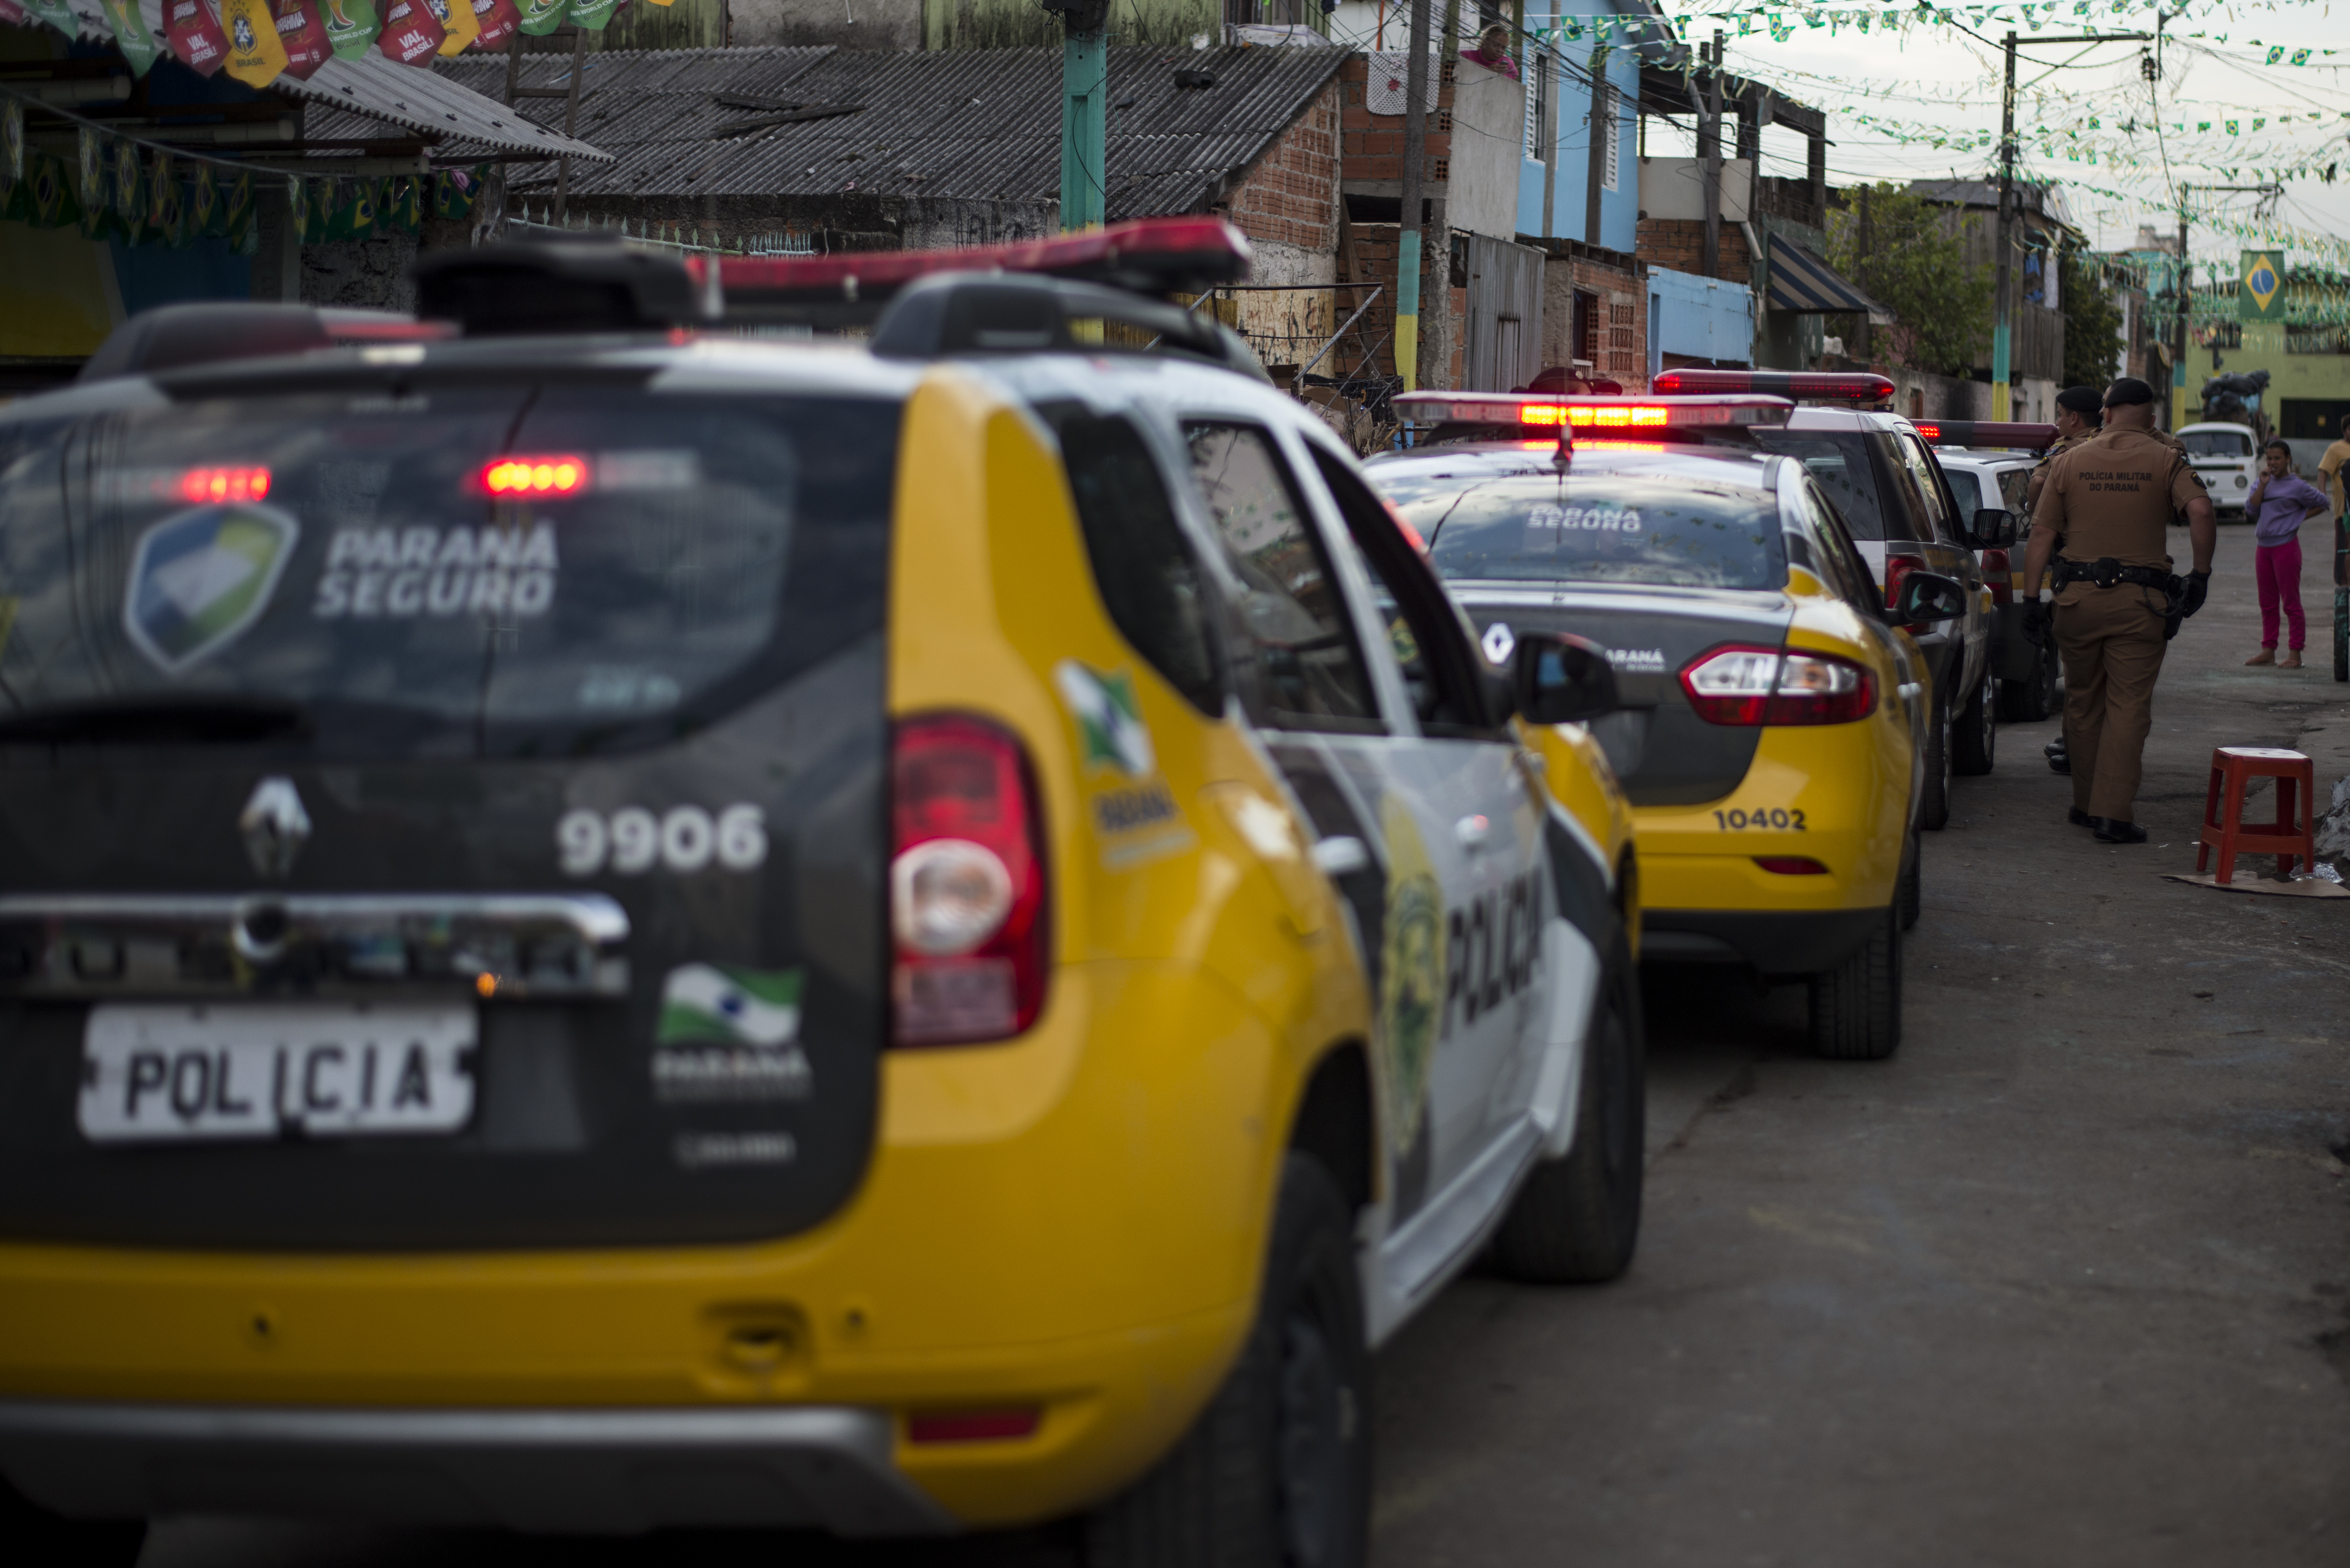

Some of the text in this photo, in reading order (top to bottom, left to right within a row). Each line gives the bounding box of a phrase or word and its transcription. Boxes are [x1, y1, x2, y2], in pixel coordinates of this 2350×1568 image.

[174, 0, 196, 19] BRAHMA
[388, 2, 412, 23] BRAHMA
[534, 8, 556, 22] WORLD
[556, 0, 565, 9] CUP
[580, 4, 602, 15] WORLD
[276, 11, 306, 34] BRAHMA
[447, 28, 460, 36] SIL
[187, 33, 208, 50] VAI,
[333, 32, 358, 42] WORLD
[359, 27, 373, 35] CUP
[398, 30, 425, 49] VAI,
[191, 46, 218, 65] BRASIL!
[402, 38, 434, 61] BRASIL!
[236, 58, 265, 67] BRASIL
[2079, 470, 2152, 482] POLÍCIA MILITAR
[2089, 482, 2139, 492] DO PARANÁ
[1527, 514, 1642, 533] SEGURO
[312, 569, 557, 619] SEGURO
[1605, 648, 1665, 664] ARANÁ
[1713, 807, 1806, 831] 10402
[557, 803, 768, 875] 9906
[124, 1041, 432, 1120] POLICIA
